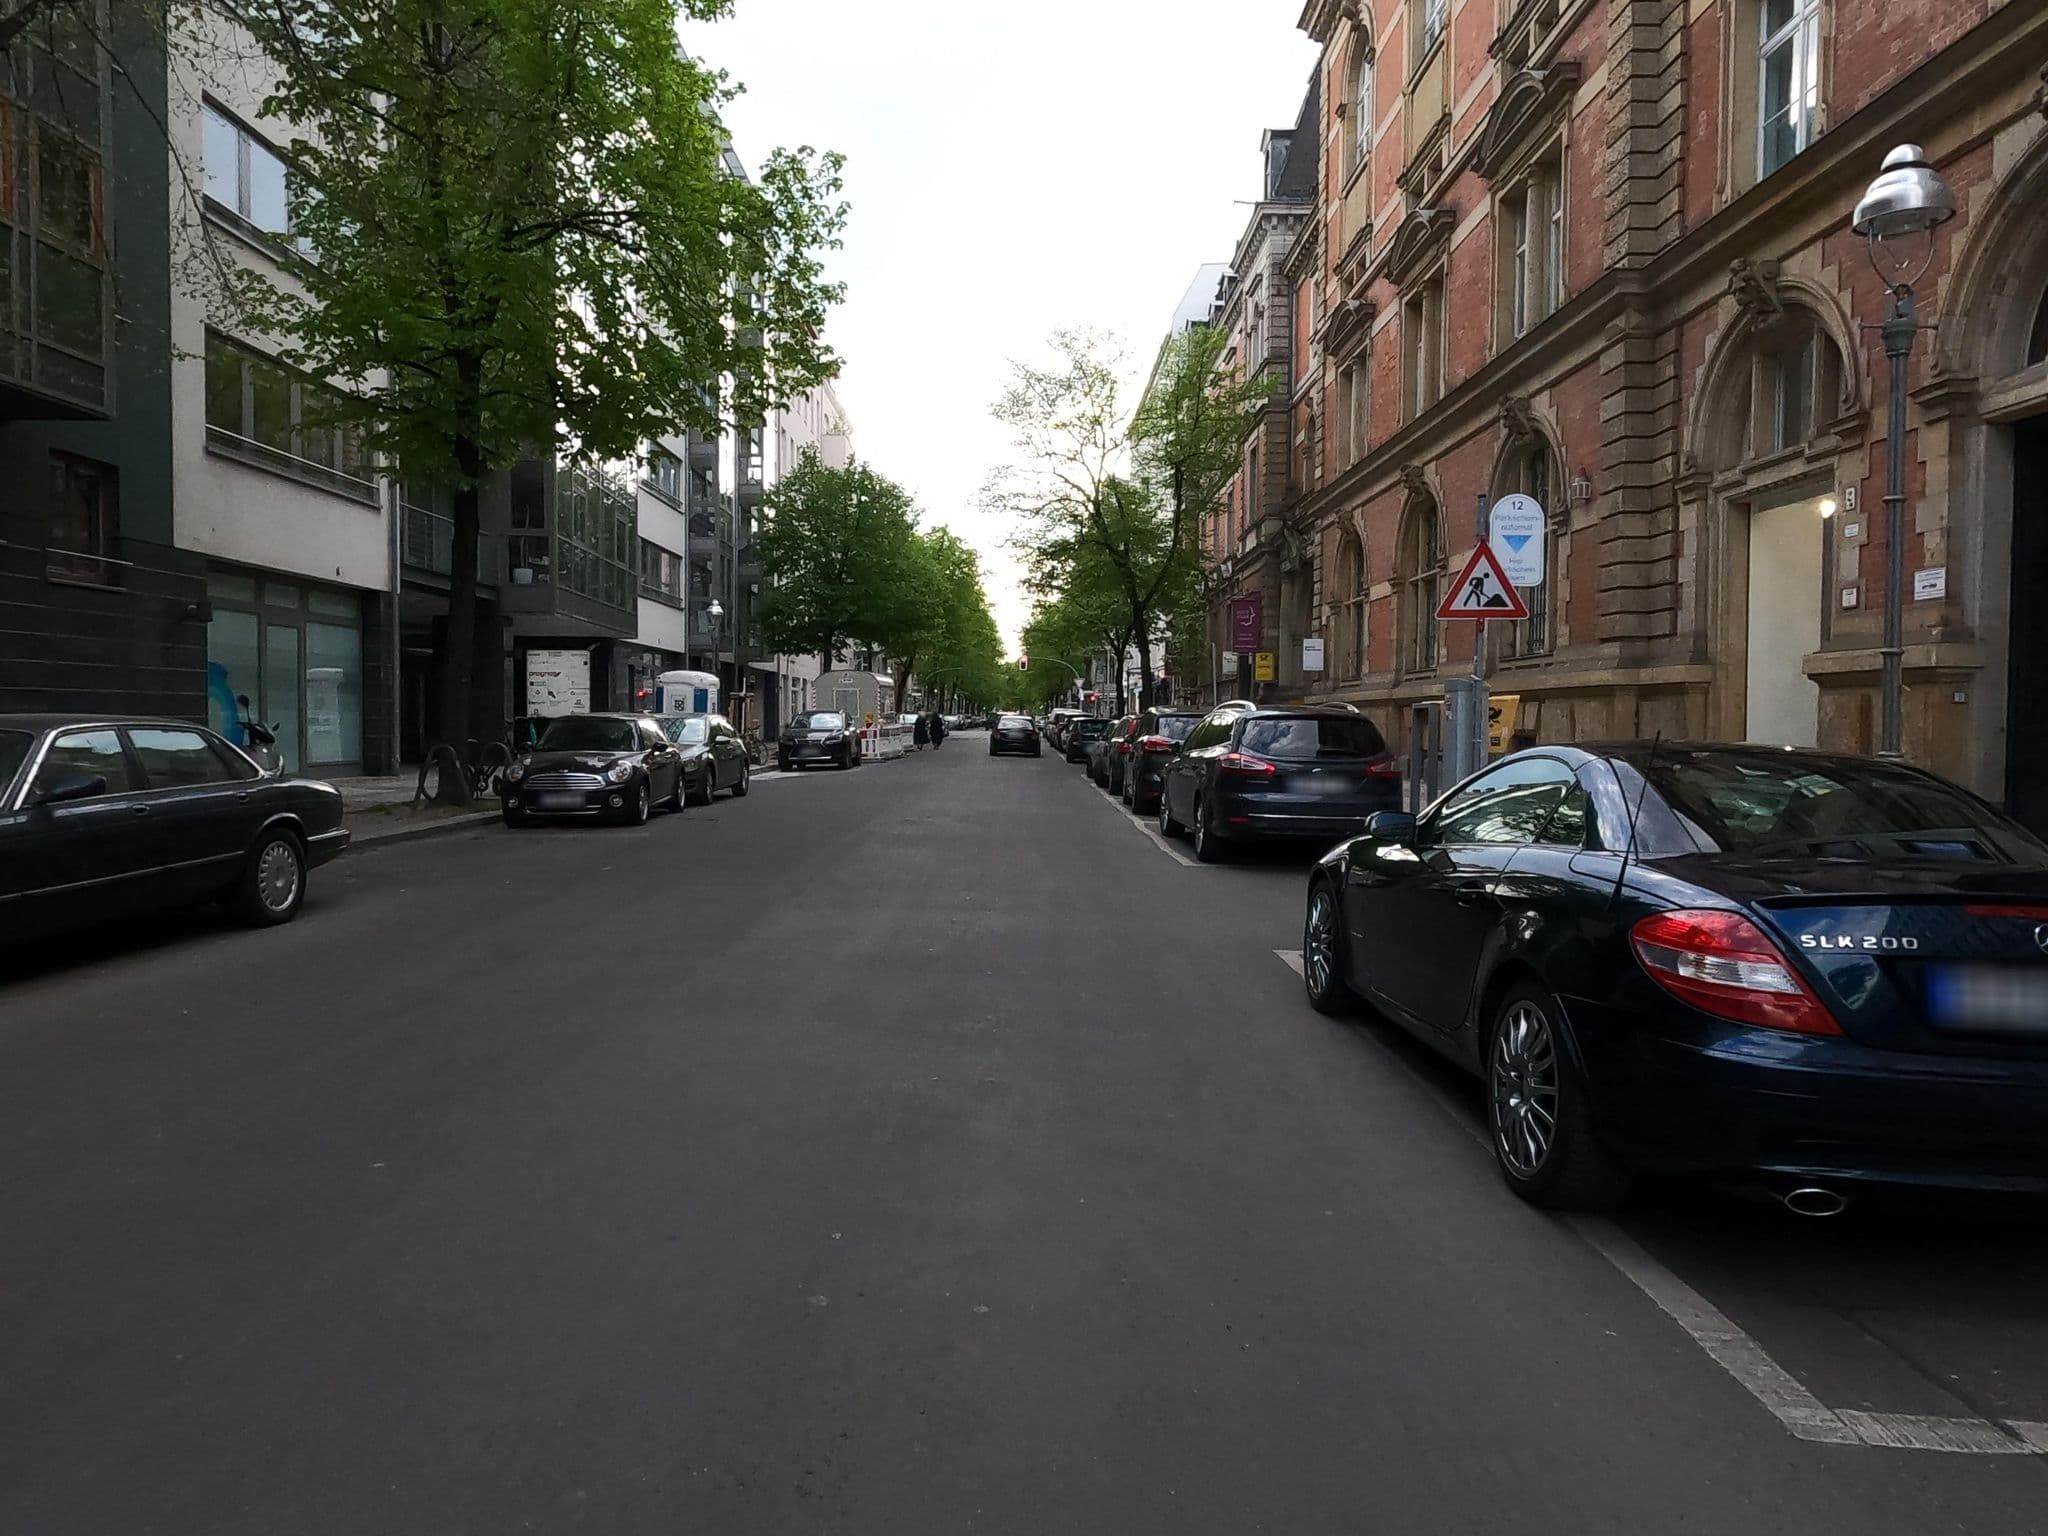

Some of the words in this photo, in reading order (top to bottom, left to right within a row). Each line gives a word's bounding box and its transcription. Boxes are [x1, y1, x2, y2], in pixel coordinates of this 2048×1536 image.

[1512, 501, 1524, 510] 12
[1800, 934, 1854, 949] SLK
[1862, 935, 1919, 950] 200
